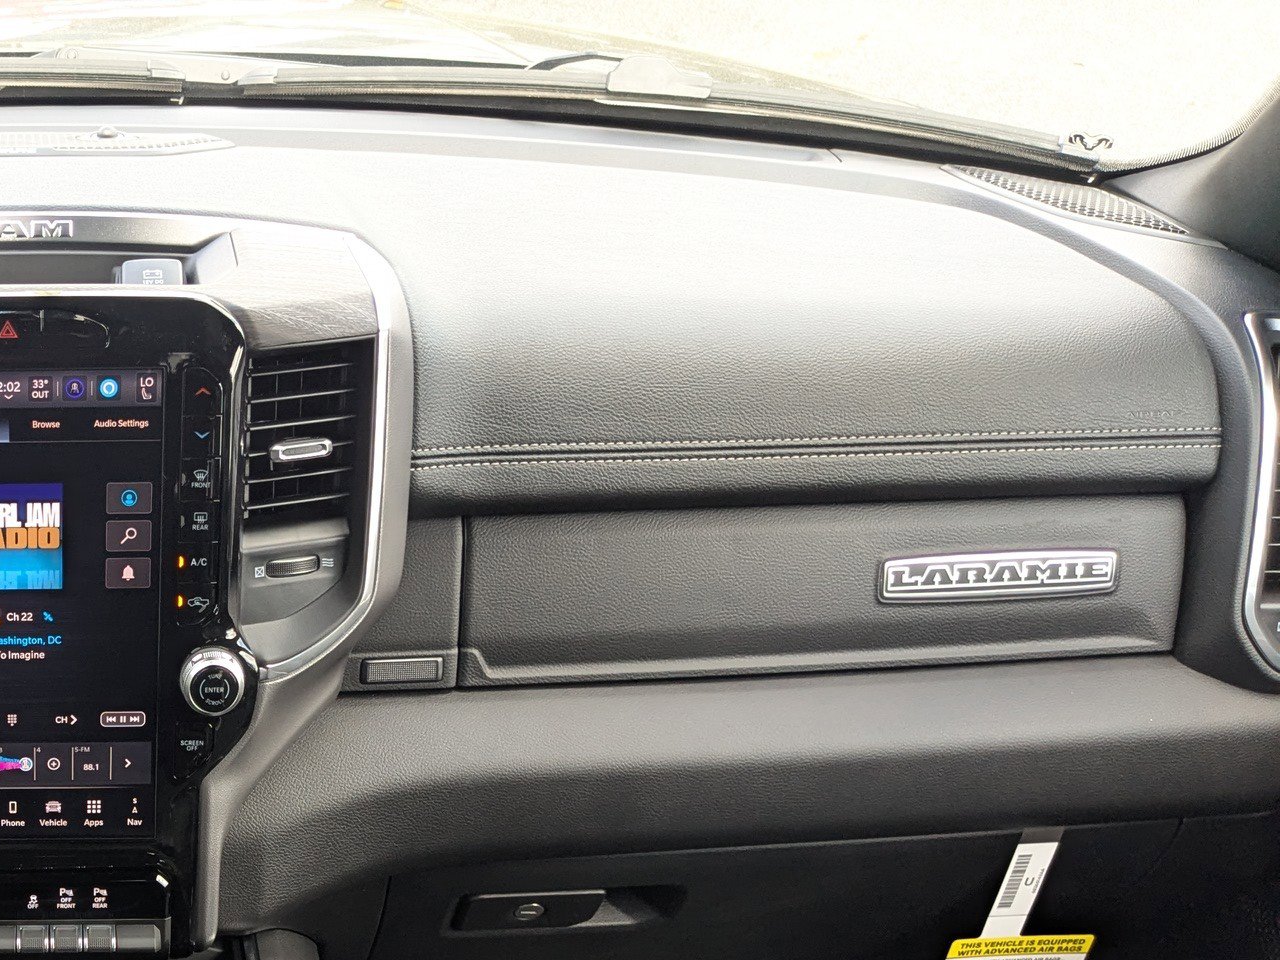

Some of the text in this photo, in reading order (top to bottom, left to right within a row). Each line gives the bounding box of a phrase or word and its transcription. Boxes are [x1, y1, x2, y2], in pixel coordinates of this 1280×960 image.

[140, 376, 155, 387] LO
[31, 389, 50, 399] OUT
[31, 420, 61, 429] Browse
[93, 418, 150, 430] Audio Settings
[191, 481, 212, 489] FRONT
[24, 502, 61, 528] JAM
[191, 523, 209, 531] REAR
[190, 557, 208, 567] A/C
[889, 560, 1110, 587] LARAMIE
[6, 611, 34, 622] Ch 22
[47, 635, 62, 645] DC
[7, 650, 45, 663] Imagine
[204, 686, 225, 694] ENTER
[54, 715, 68, 724] CH
[180, 739, 204, 747] SCREEN
[83, 763, 100, 771] 88.1
[0, 818, 26, 827] Phone
[38, 818, 68, 827] Vehicle
[83, 818, 104, 828] Apps
[126, 817, 143, 826] Nav
[960, 942, 982, 950] THIS
[983, 940, 1024, 949] VEHICLE
[1037, 938, 1086, 946] EQUIPPED
[957, 949, 983, 957] WITH
[984, 947, 1037, 956] ADVANCED
[1056, 945, 1083, 953] BAGS
